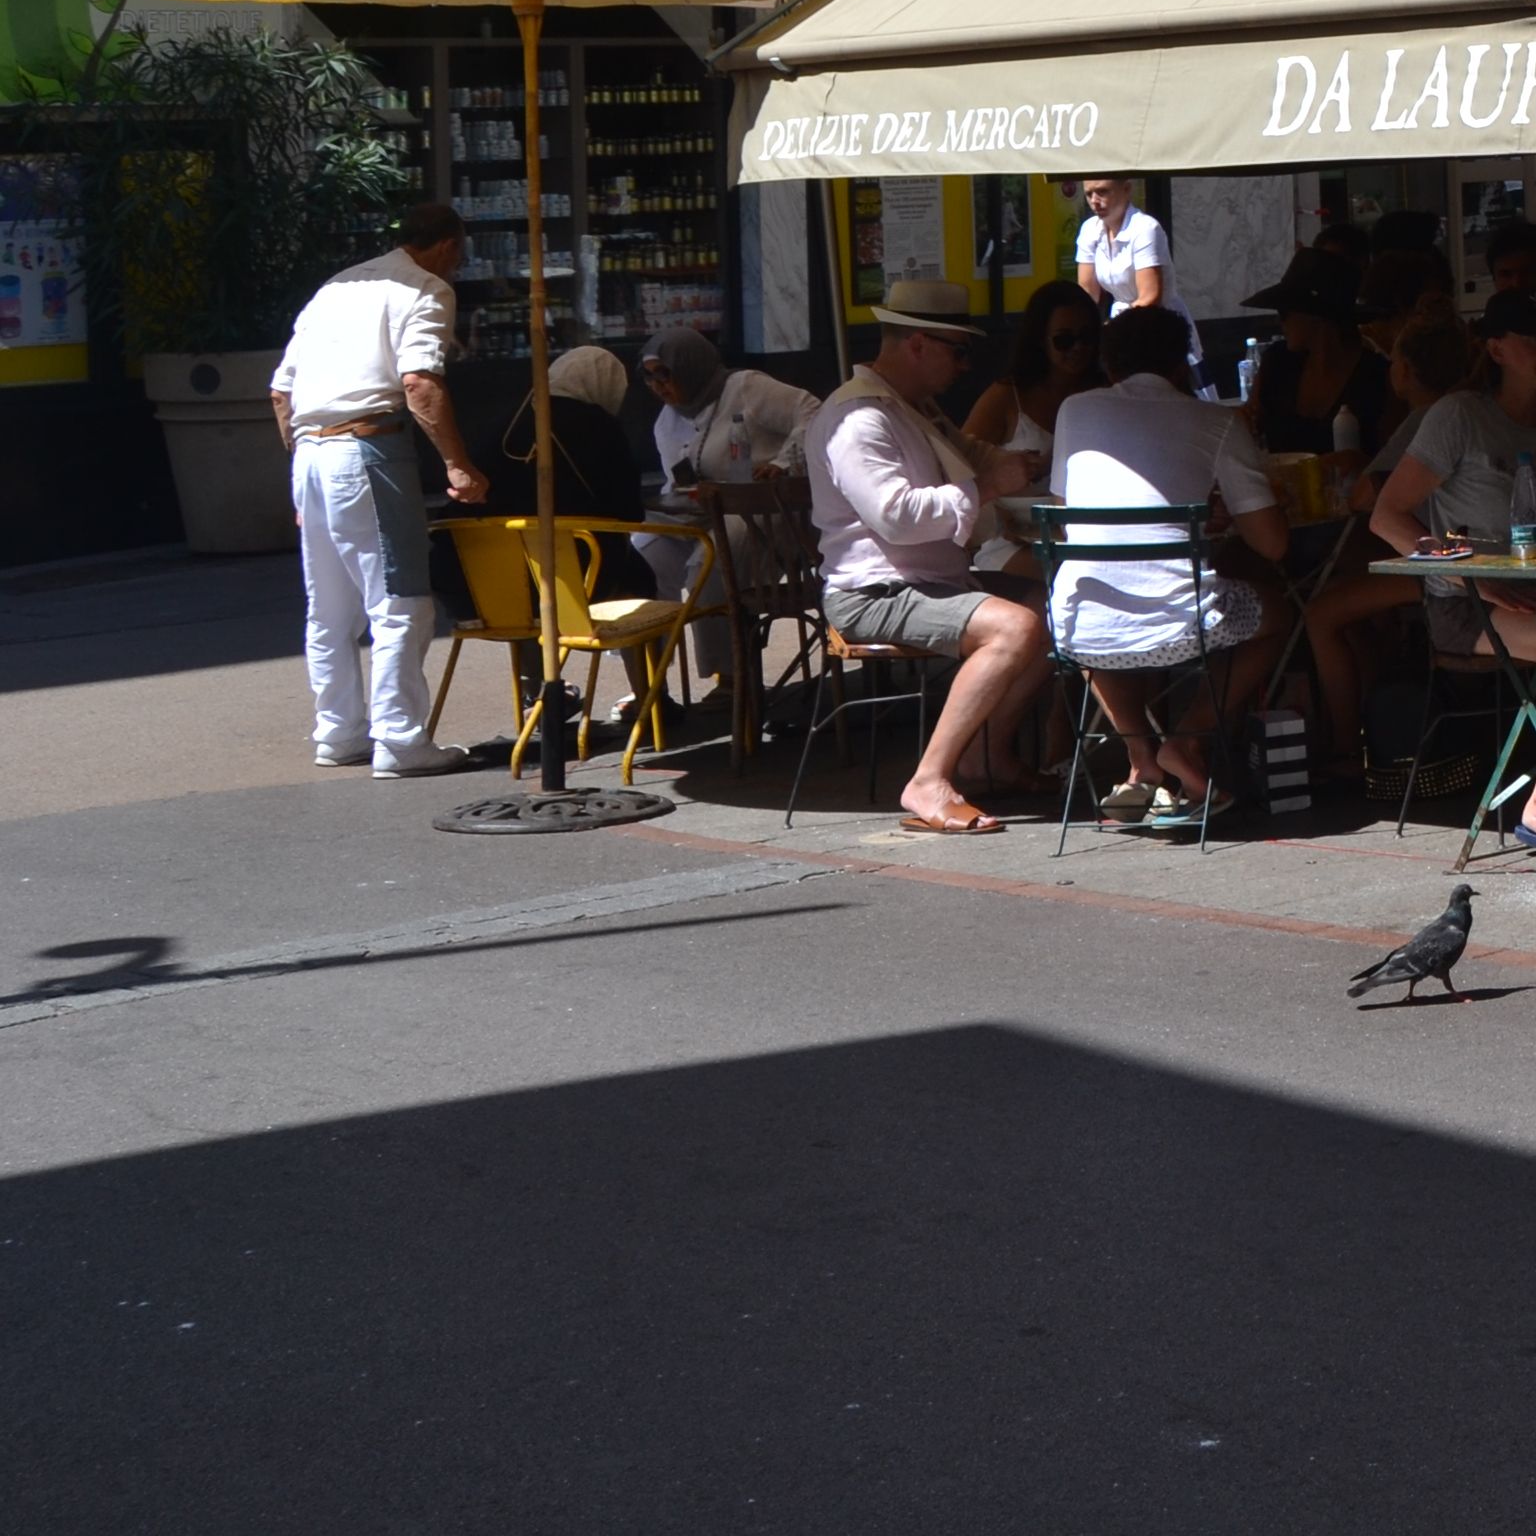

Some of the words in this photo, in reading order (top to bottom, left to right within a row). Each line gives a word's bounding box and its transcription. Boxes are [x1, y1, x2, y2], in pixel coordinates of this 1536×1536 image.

[1262, 50, 1353, 137] DA
[757, 111, 870, 162] DELIZIE
[871, 110, 934, 154] DEL
[936, 100, 1099, 154] MERCATO
